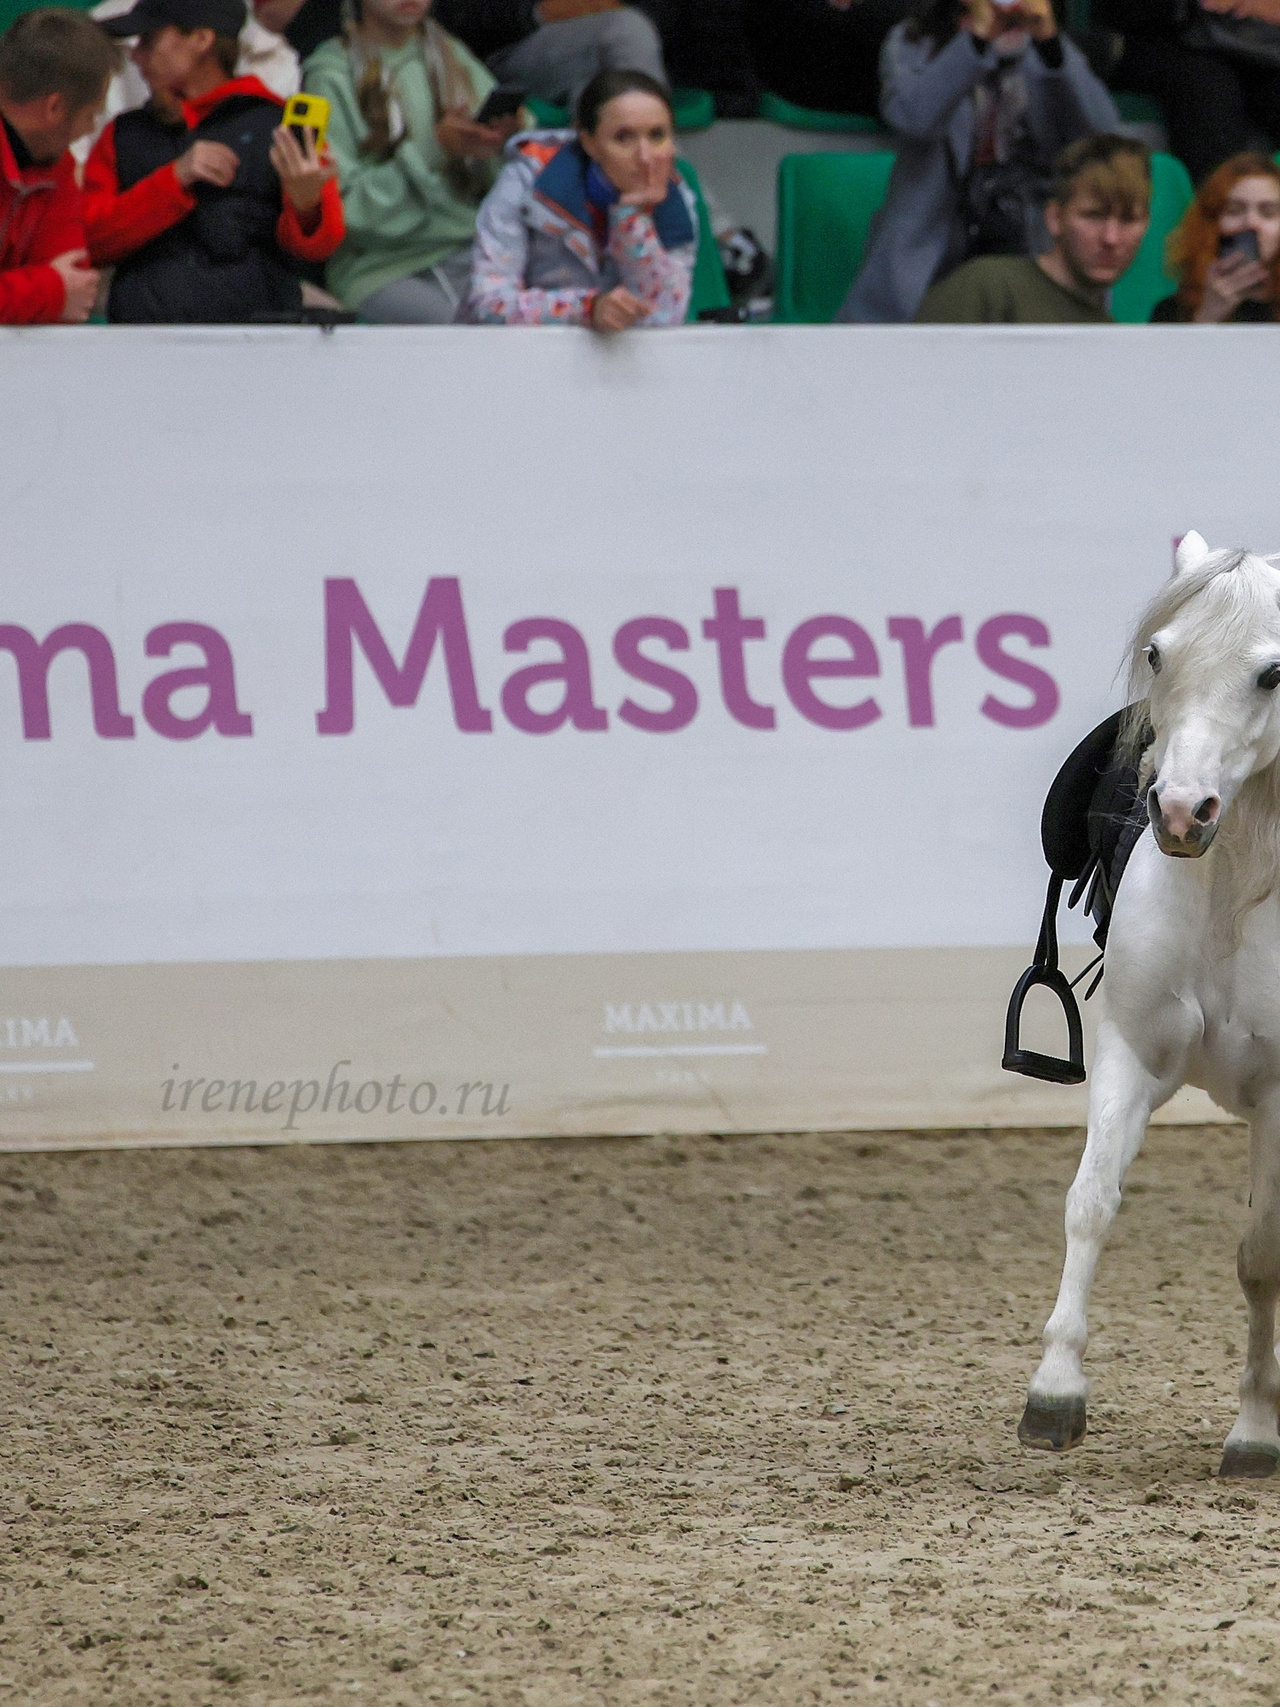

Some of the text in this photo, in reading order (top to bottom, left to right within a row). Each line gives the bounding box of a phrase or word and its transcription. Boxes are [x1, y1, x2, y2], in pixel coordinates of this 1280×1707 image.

[315, 576, 1060, 738] Masters
[0, 1017, 78, 1047] IMA
[604, 1002, 752, 1033] MAXIMA
